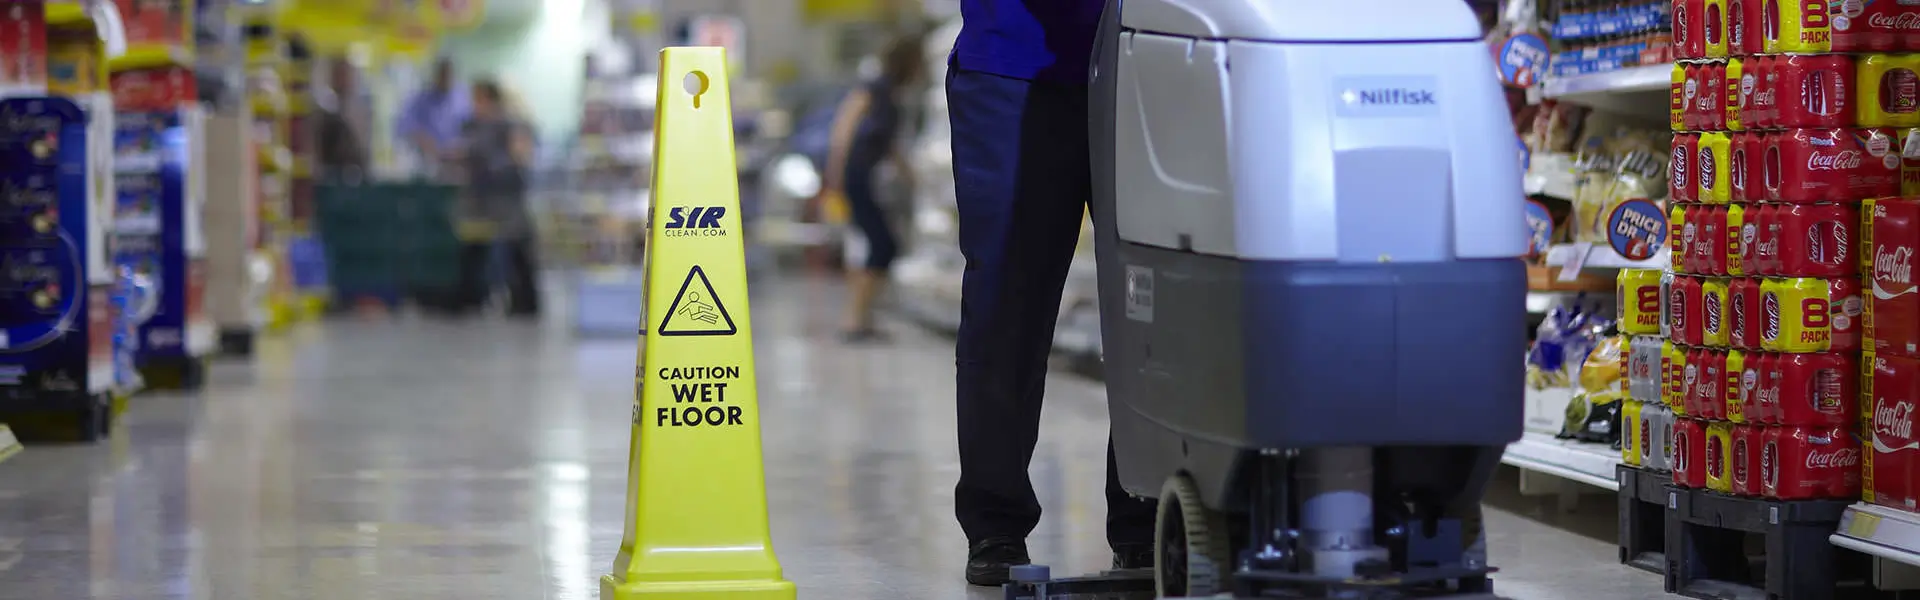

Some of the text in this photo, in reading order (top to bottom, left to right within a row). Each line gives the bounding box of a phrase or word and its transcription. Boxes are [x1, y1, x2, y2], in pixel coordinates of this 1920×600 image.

[1801, 30, 1829, 43] PACK
[1360, 88, 1436, 105] Nilfisk
[665, 206, 726, 228] SIR
[1622, 208, 1662, 235] PRICE
[665, 229, 727, 237] CLEAN.COM
[1802, 298, 1830, 328] 8
[1801, 330, 1829, 343] PACK
[659, 366, 740, 380] CAUTION
[671, 383, 727, 403] WET
[657, 406, 743, 426] FLOOR
